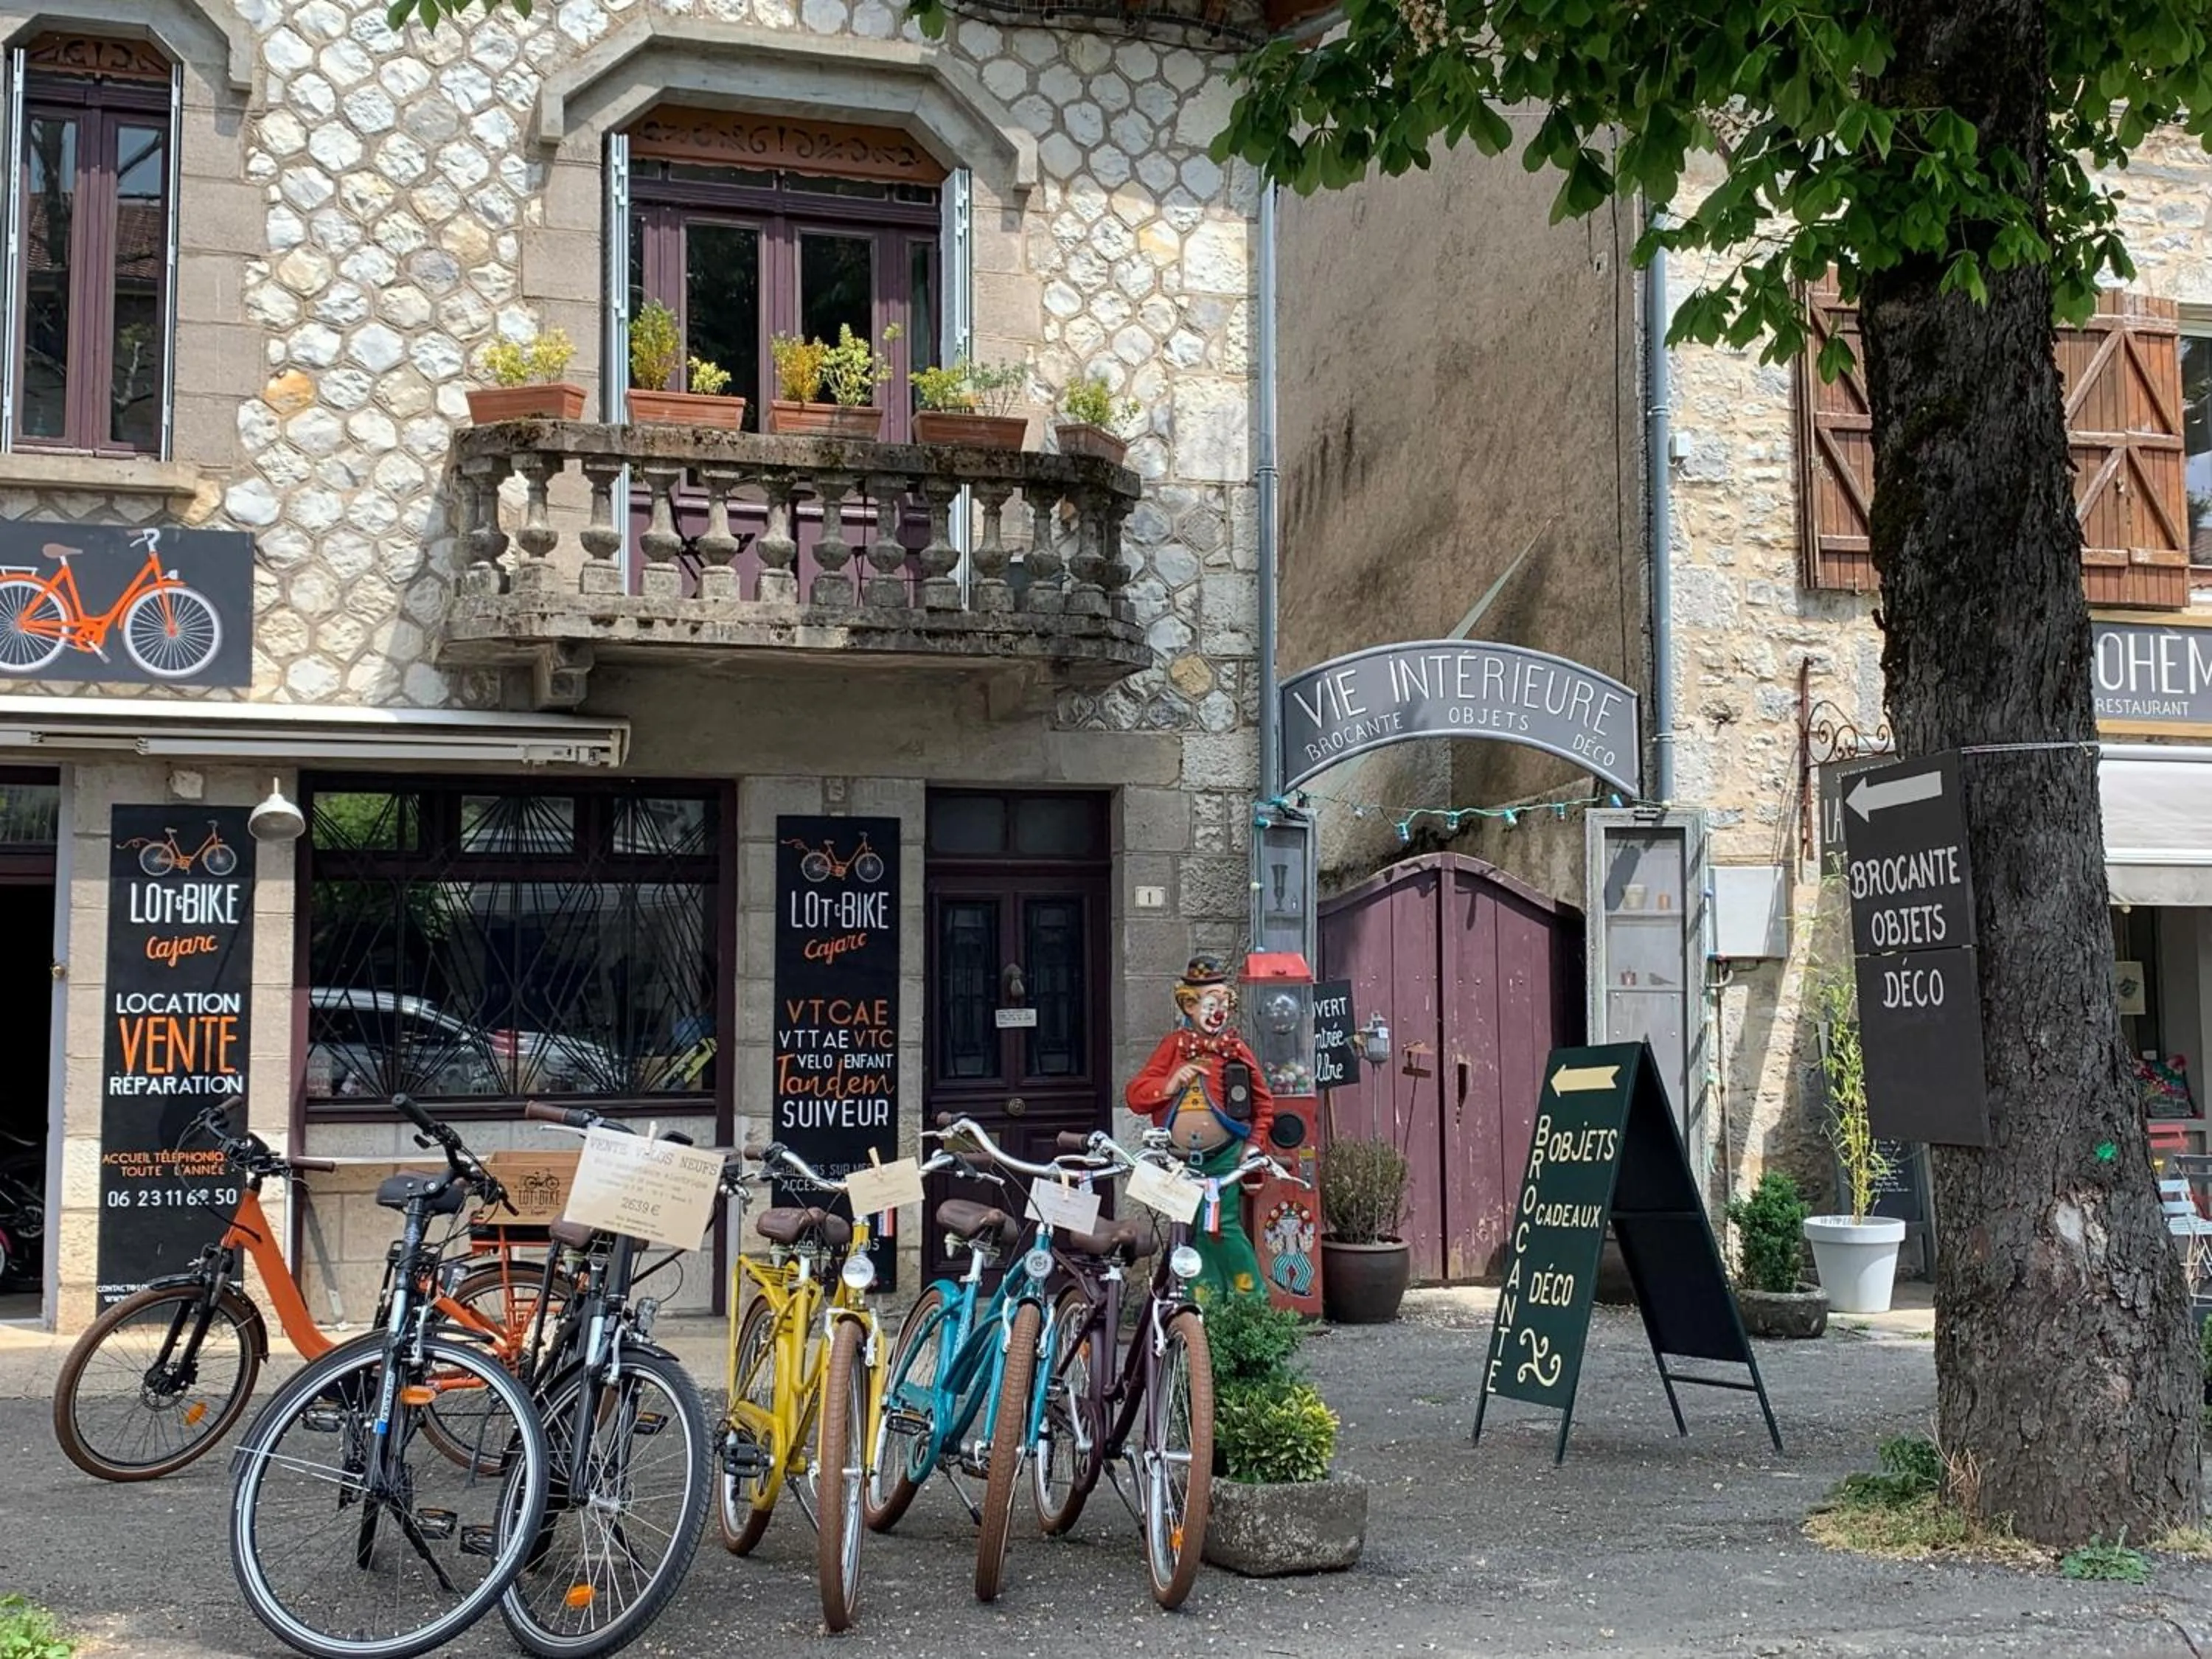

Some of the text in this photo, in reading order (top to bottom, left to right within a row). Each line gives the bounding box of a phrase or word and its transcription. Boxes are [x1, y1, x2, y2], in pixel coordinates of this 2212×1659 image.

[1293, 650, 1622, 737] VIE INTÉRIEURE
[2095, 698, 2189, 717] RESTAURANT
[1304, 706, 1615, 767] BROCANTE OBJETS DÉCO
[1851, 846, 1961, 900] BROCANTE
[1871, 904, 1947, 947] OBJETS
[147, 934, 218, 967] Cajarc
[804, 932, 868, 965] Cajarc
[1883, 957, 1945, 1009] DÉCO
[116, 992, 240, 1014] LOCATION
[1312, 997, 1347, 1018] VERT
[119, 1017, 237, 1074] VENTE
[854, 1029, 894, 1048] VTC
[1315, 1022, 1344, 1050] ntrée
[776, 1053, 895, 1099] Tandem
[844, 1053, 894, 1069] ENFANT
[109, 1071, 243, 1096] RÉPARATION
[782, 1099, 889, 1128] SUIVEUR
[1548, 1121, 1618, 1163] OBJETS
[102, 1152, 151, 1165] ACCUEIL
[121, 1162, 225, 1177] TOUTE L'ANNÉE
[636, 1145, 674, 1165] VLOS
[678, 1155, 719, 1176] NEUFS
[107, 1190, 130, 1207] 06
[137, 1189, 161, 1207] 23
[165, 1189, 182, 1206] 11
[215, 1188, 237, 1205] 50
[1535, 1203, 1602, 1229] CADEAUX
[1486, 1114, 1551, 1394] BROCANTE
[1528, 1263, 1574, 1308] DÉCO
